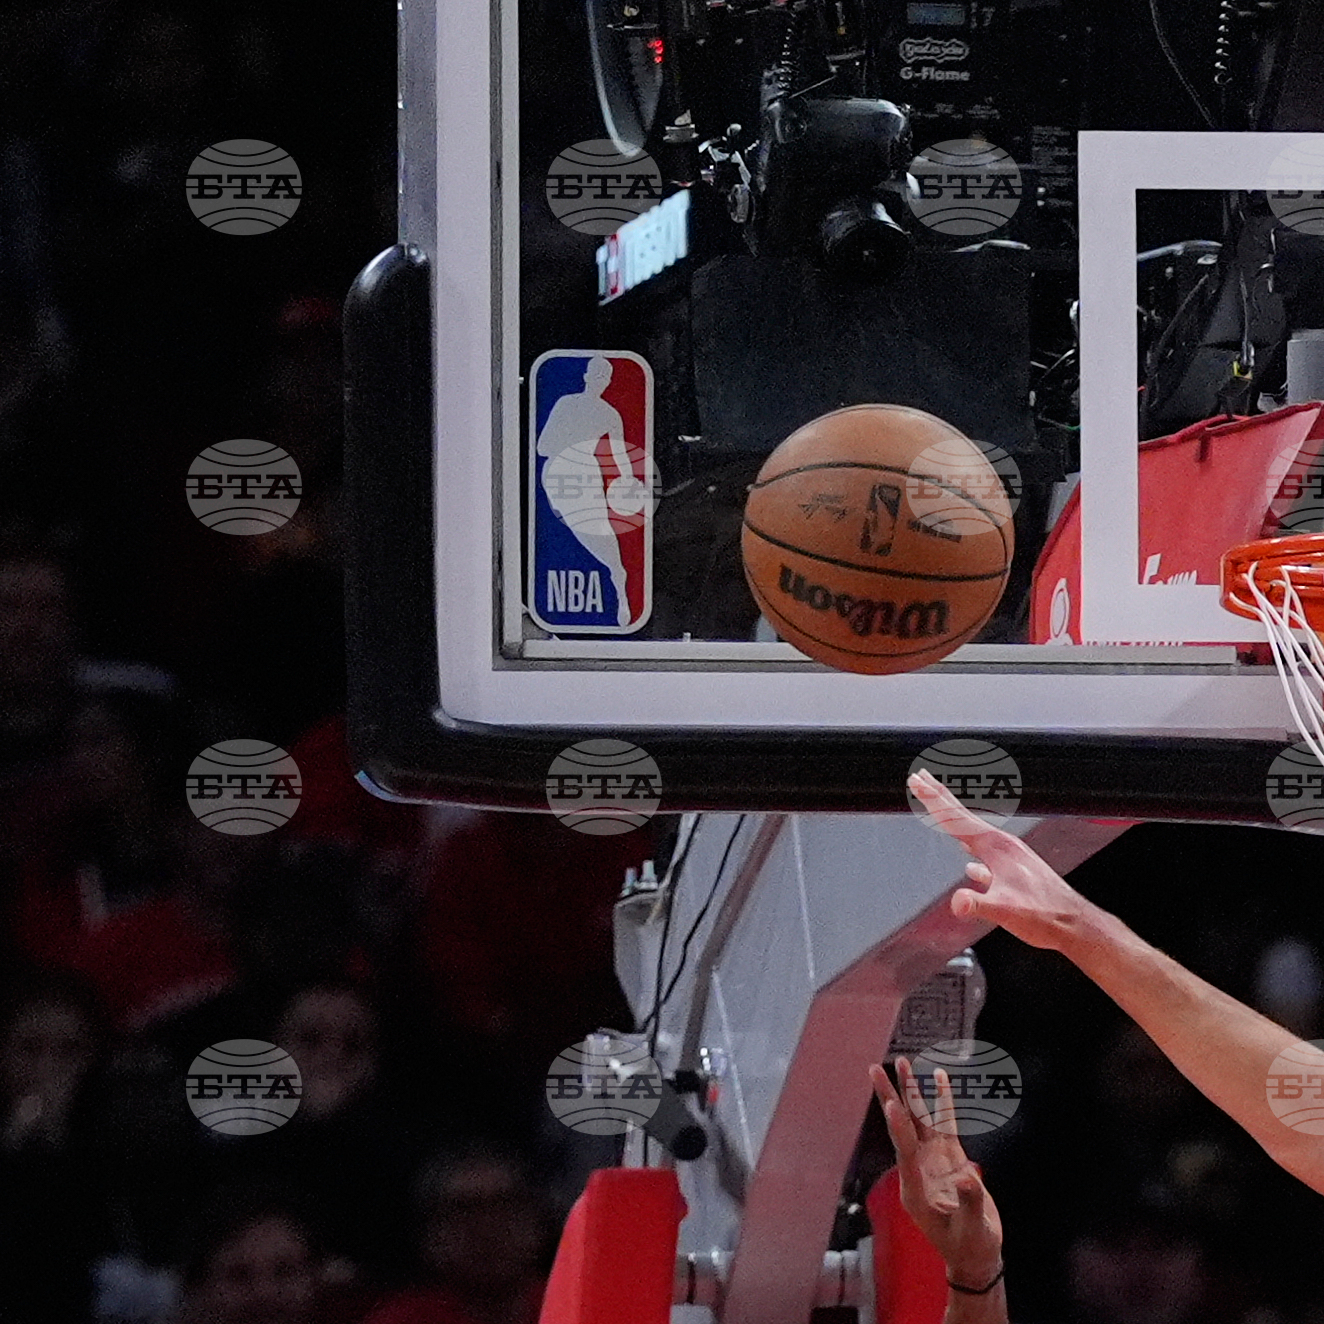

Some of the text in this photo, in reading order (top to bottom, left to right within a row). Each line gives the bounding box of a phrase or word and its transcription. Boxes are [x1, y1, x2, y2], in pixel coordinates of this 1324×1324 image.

[900, 66, 970, 81] G-Flame
[547, 569, 604, 613] NBA
[778, 563, 950, 639] Wilson
